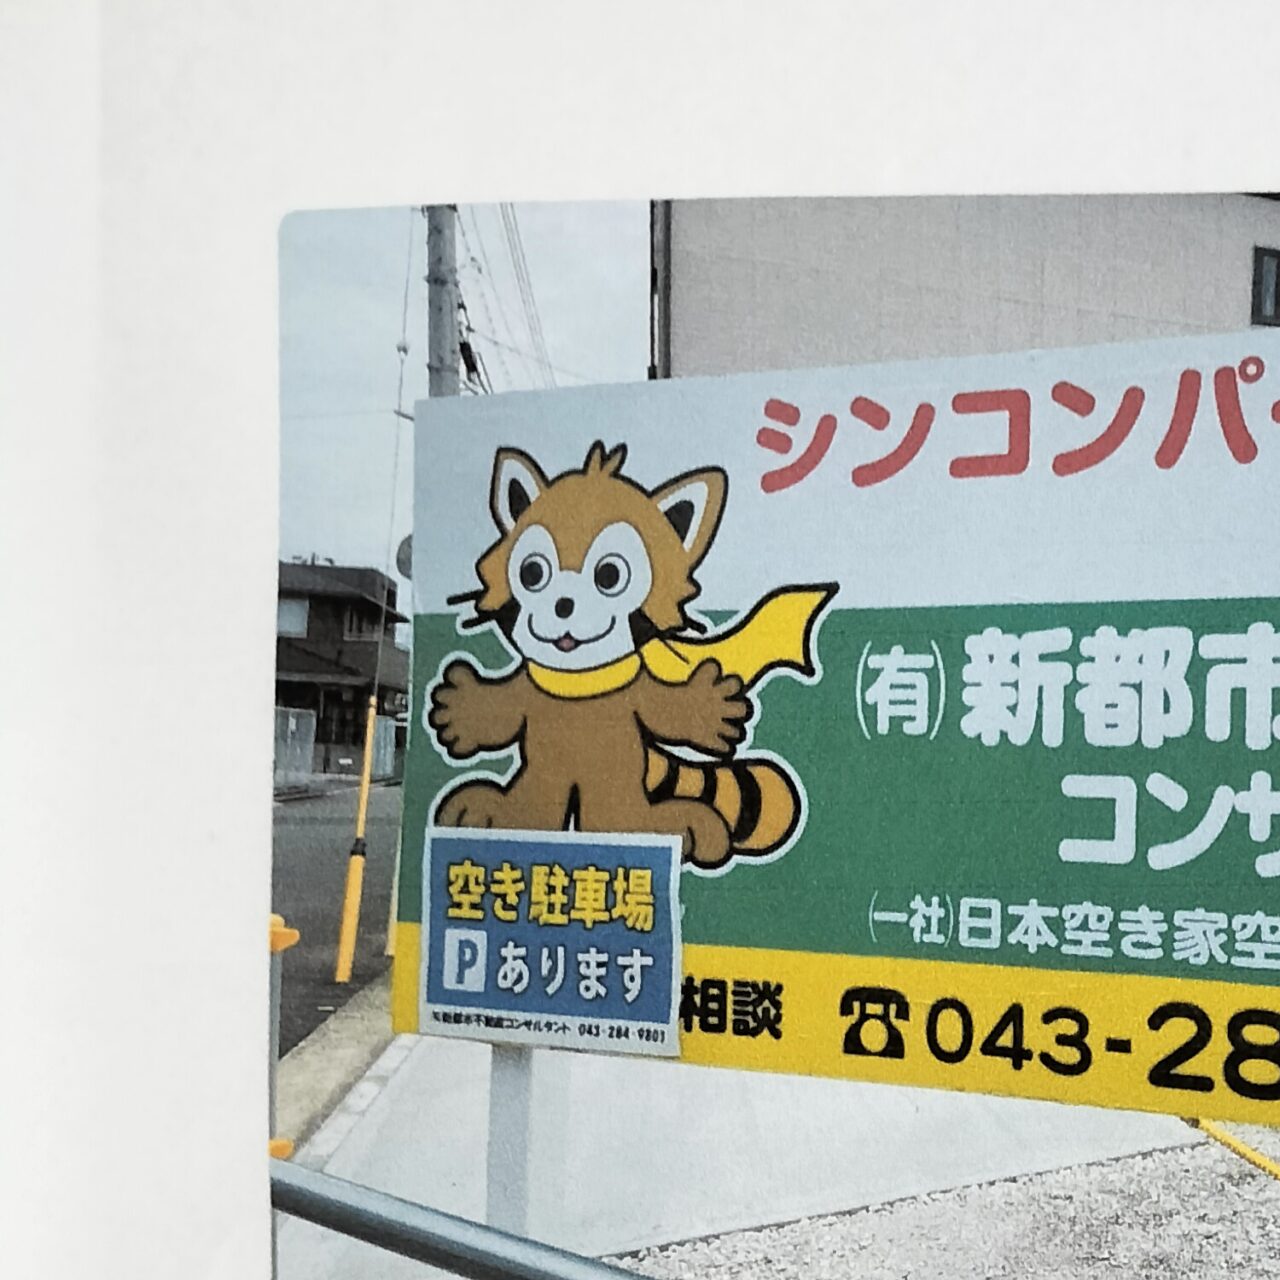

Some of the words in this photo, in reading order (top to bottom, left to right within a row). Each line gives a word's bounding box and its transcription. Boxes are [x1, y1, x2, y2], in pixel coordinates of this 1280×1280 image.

[445, 859, 656, 932] 空き駐車場
[497, 940, 654, 1003] あります
